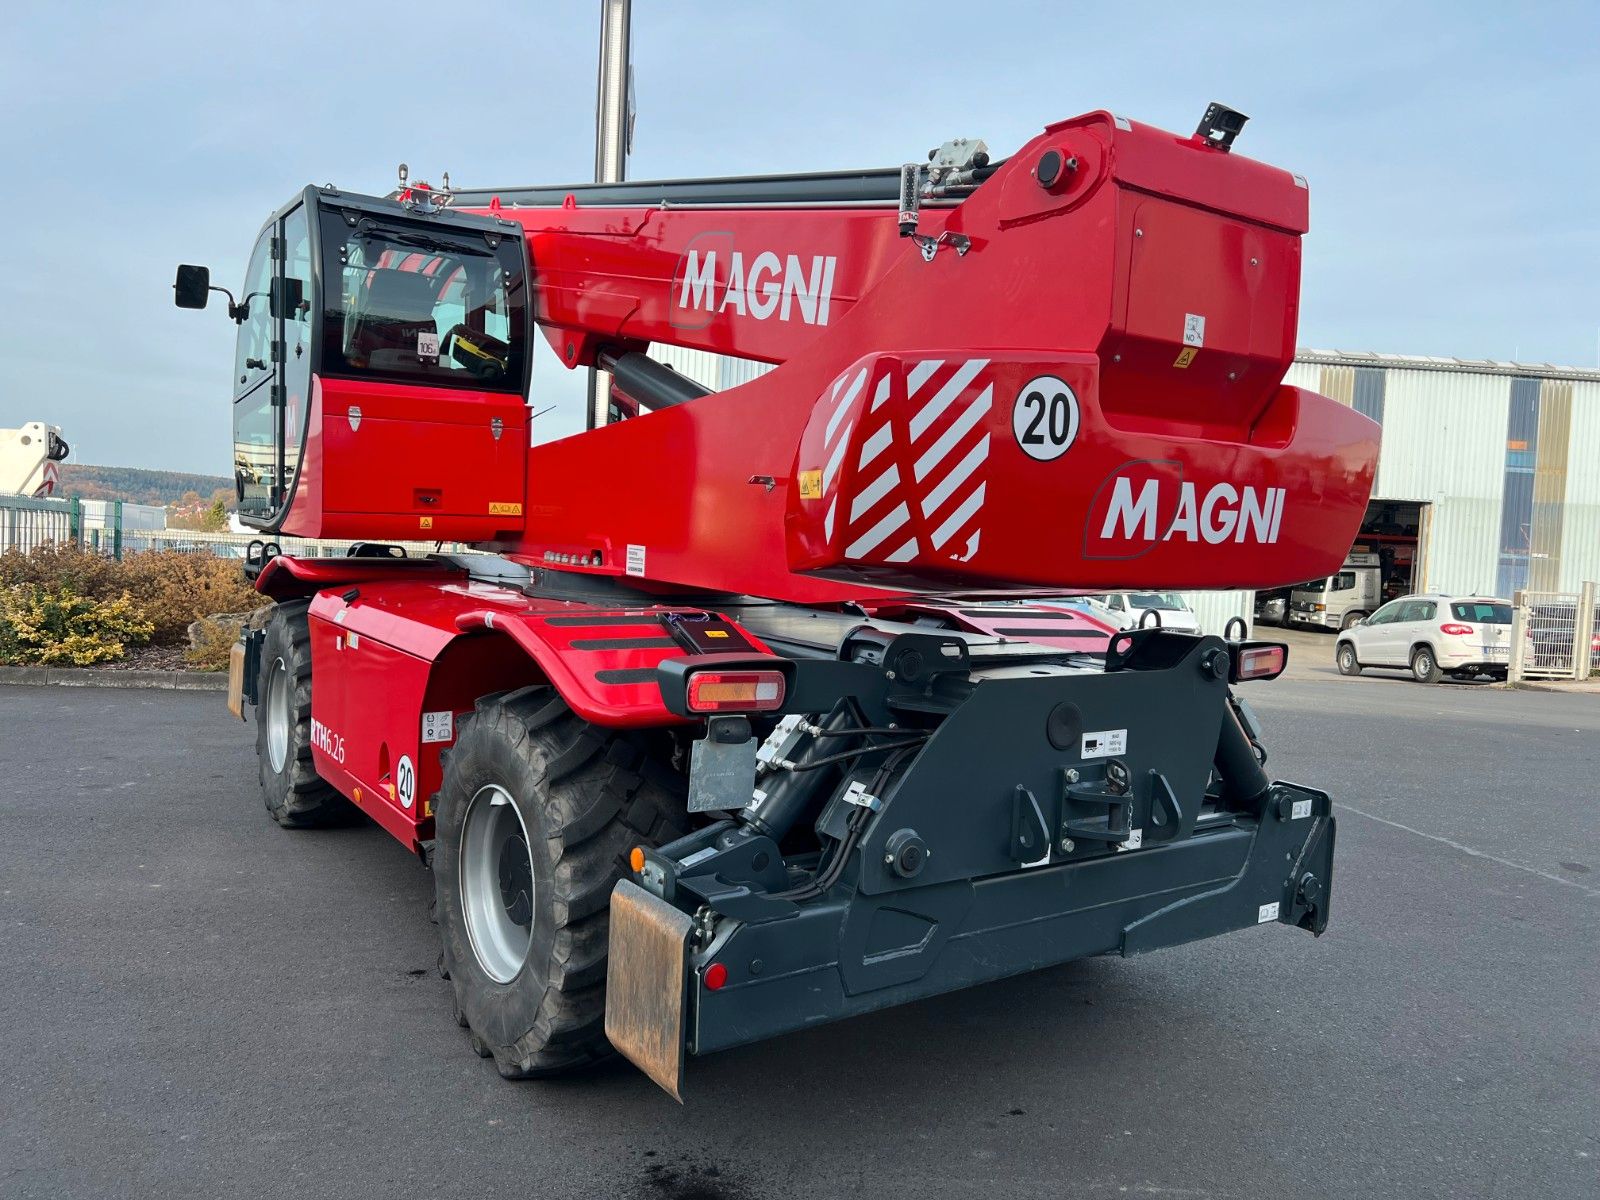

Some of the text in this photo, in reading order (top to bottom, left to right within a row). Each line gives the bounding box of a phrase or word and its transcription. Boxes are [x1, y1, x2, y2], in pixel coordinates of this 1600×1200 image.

[679, 250, 837, 326] MAGNI
[1021, 391, 1071, 446] 20
[1100, 476, 1286, 544] MAGNI
[400, 763, 412, 800] 20
